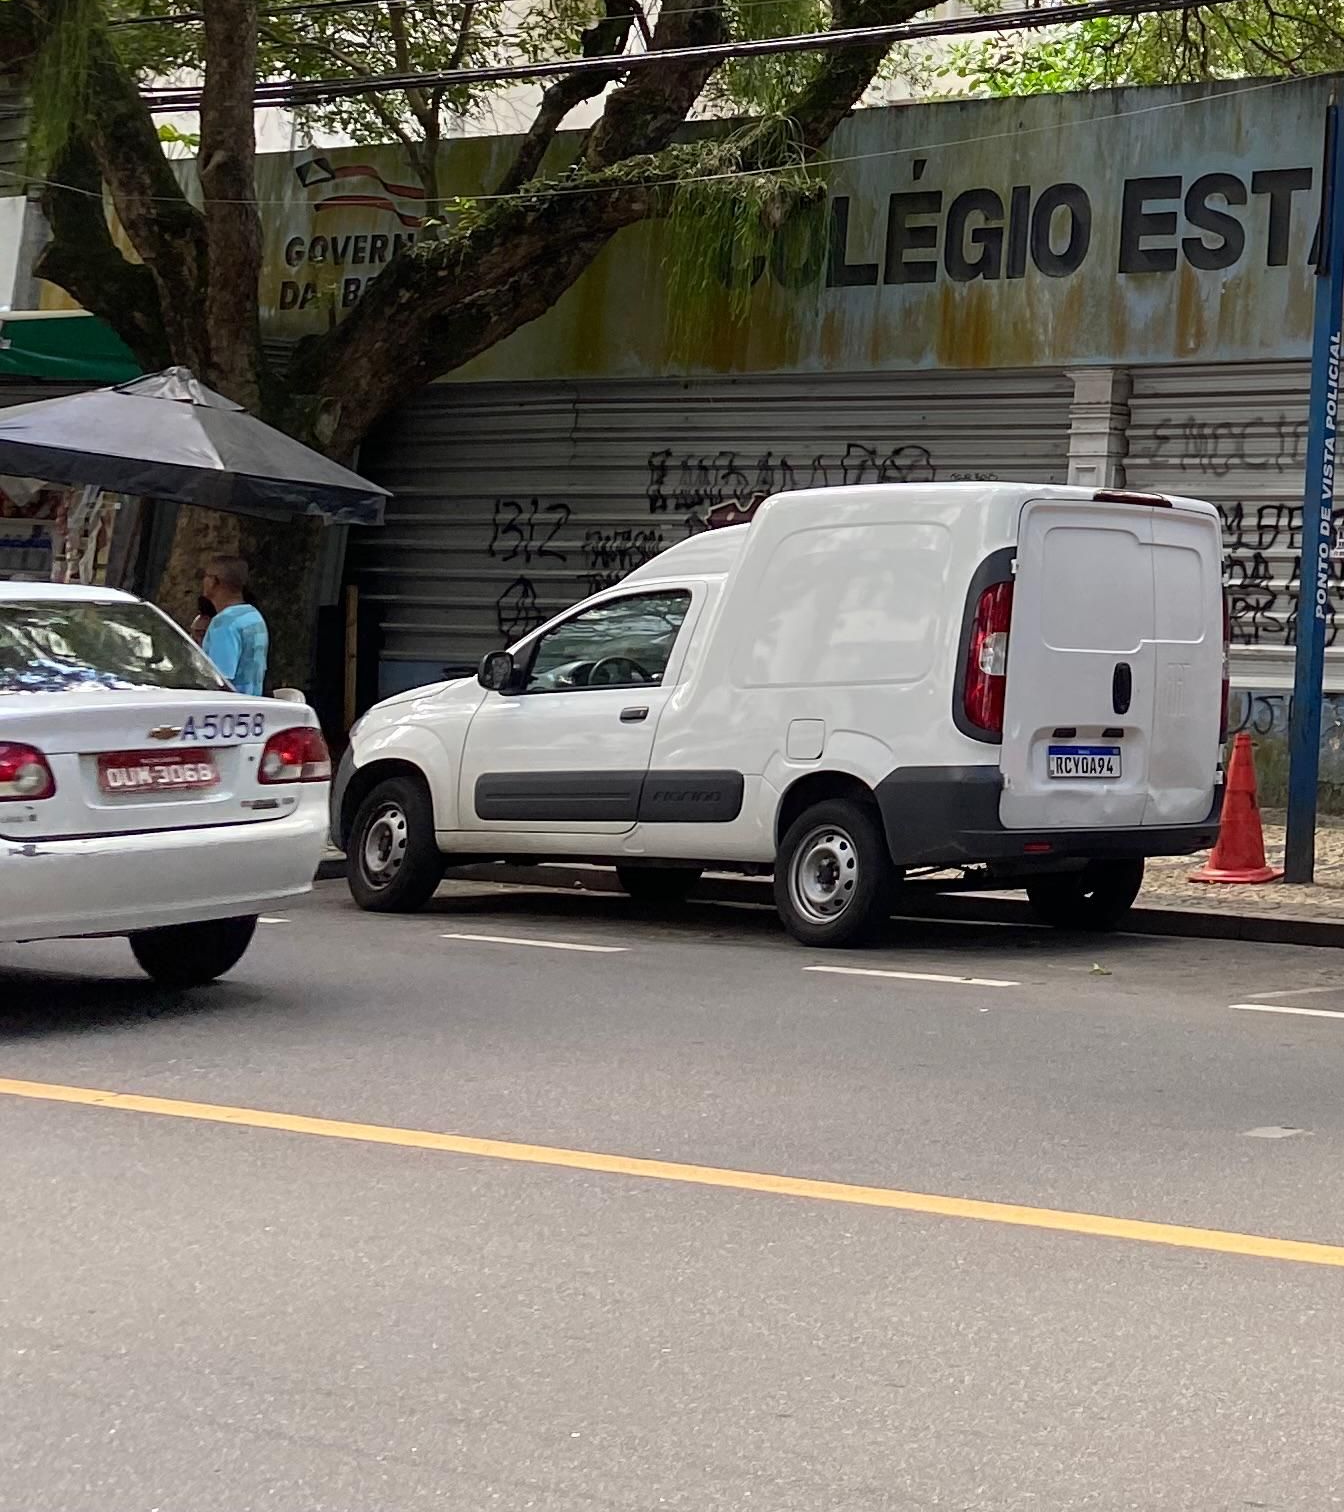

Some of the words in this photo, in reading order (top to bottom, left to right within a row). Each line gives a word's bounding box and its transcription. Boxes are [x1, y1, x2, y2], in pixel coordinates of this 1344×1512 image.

[717, 158, 1093, 289] OLÉGIO
[1325, 331, 1342, 432] POLICIAL
[1320, 436, 1336, 500] VISTA
[1319, 506, 1333, 538] DE
[1314, 540, 1330, 620] PONTO
